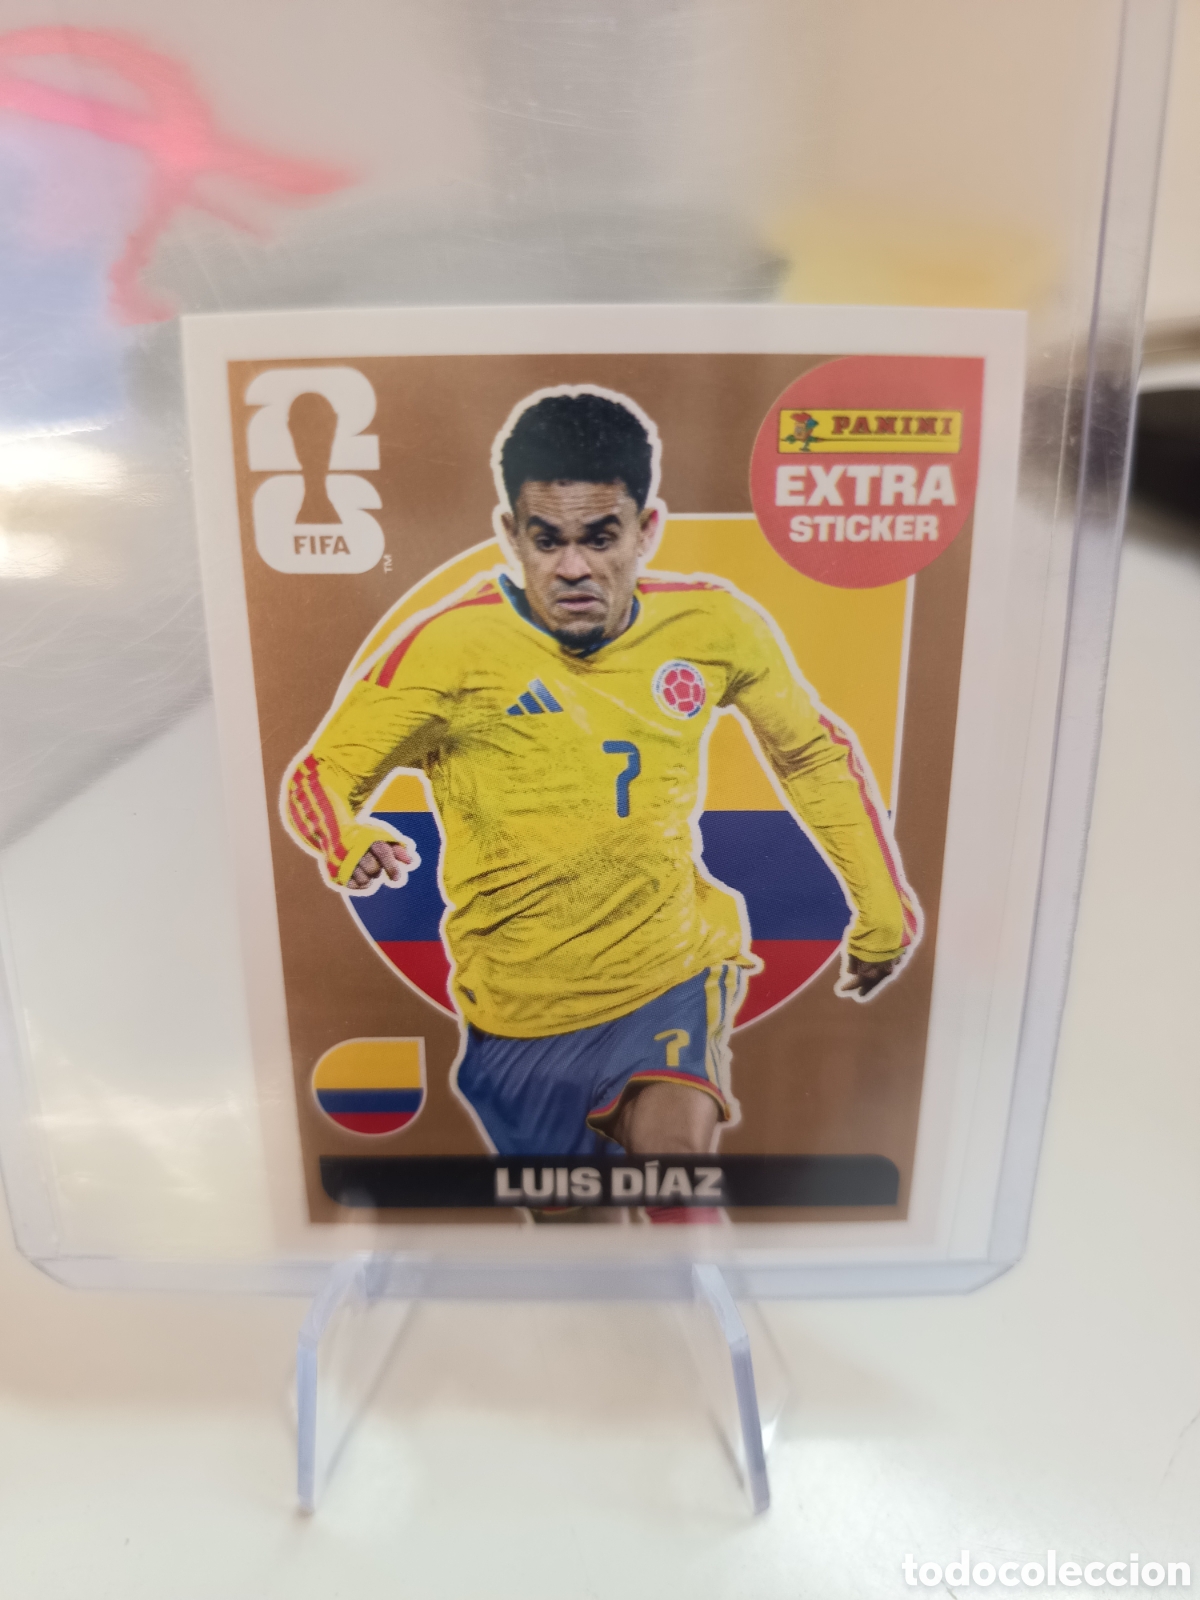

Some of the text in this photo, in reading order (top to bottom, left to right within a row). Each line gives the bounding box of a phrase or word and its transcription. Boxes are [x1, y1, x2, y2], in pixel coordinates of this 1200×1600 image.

[831, 415, 953, 436] PANINI
[775, 464, 957, 507] EXTRA
[293, 535, 351, 555] FIFA
[789, 514, 939, 543] STICKER
[602, 740, 641, 818] 7
[653, 1028, 690, 1067] 7
[495, 1160, 723, 1197] LUIS DÍAZ
